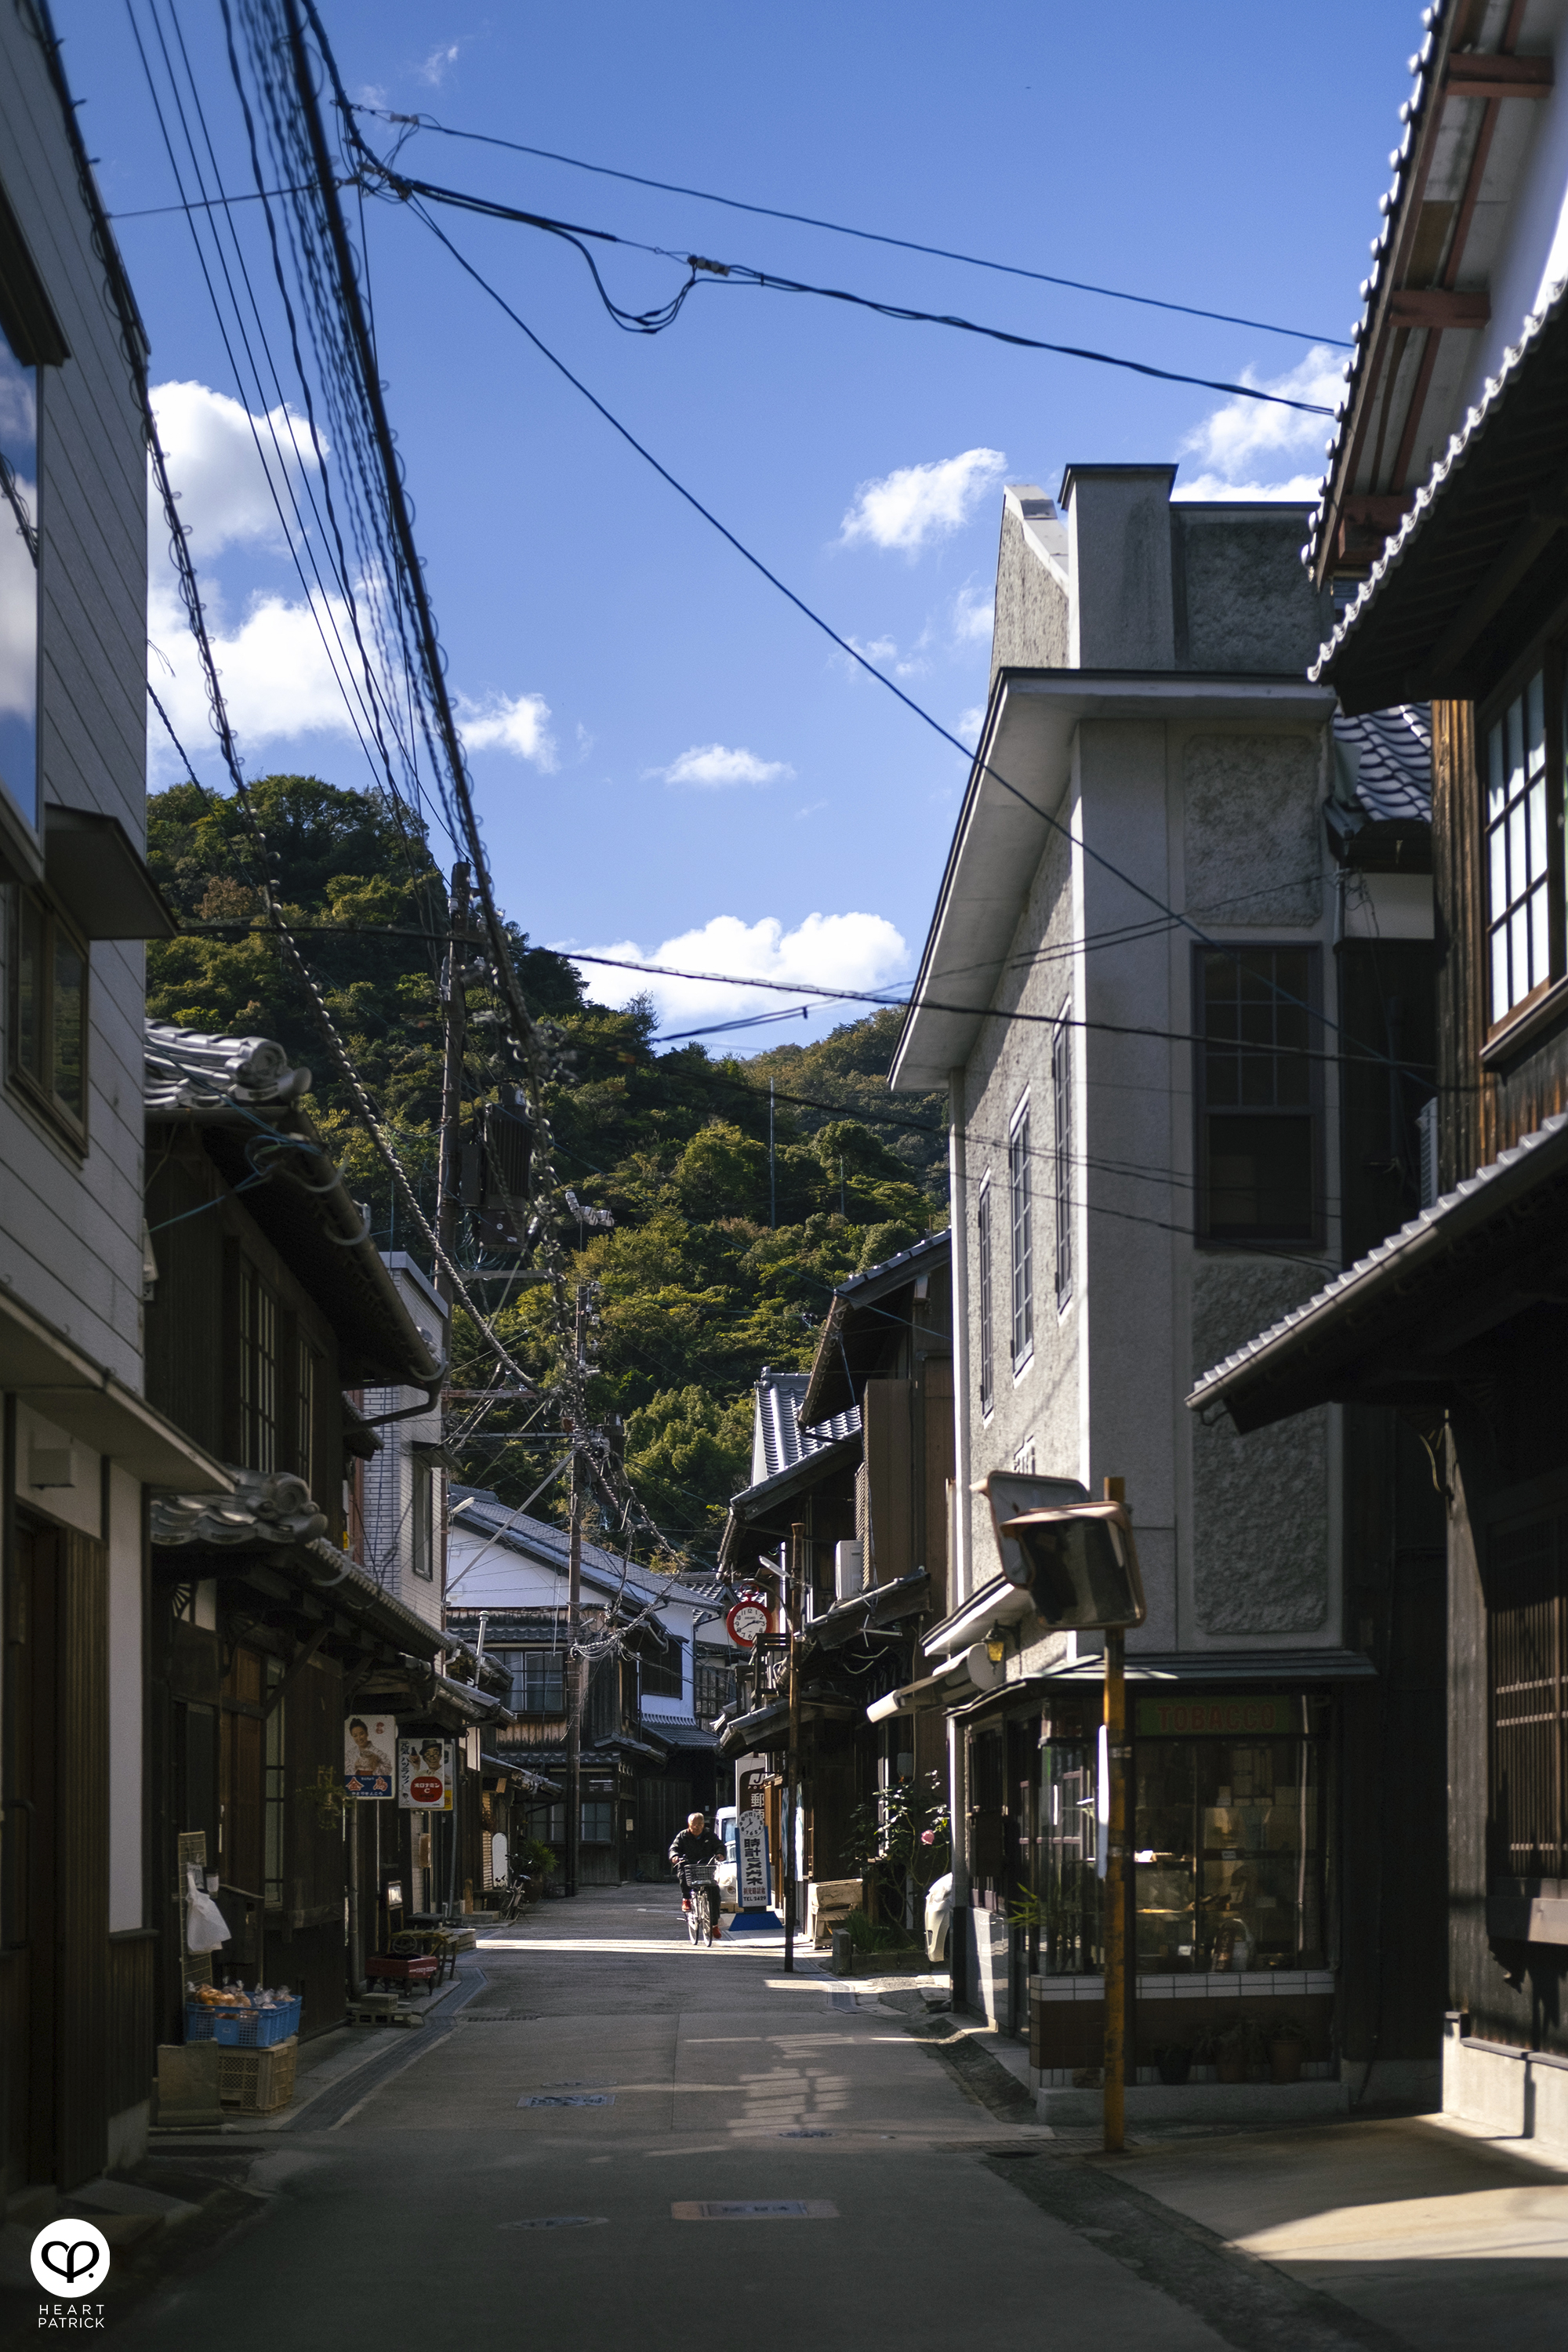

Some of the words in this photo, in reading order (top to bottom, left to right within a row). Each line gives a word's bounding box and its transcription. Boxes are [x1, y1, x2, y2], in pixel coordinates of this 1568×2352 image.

[1158, 1704, 1276, 1731] TOBACCO
[744, 1838, 763, 1886] 時計とメガネ
